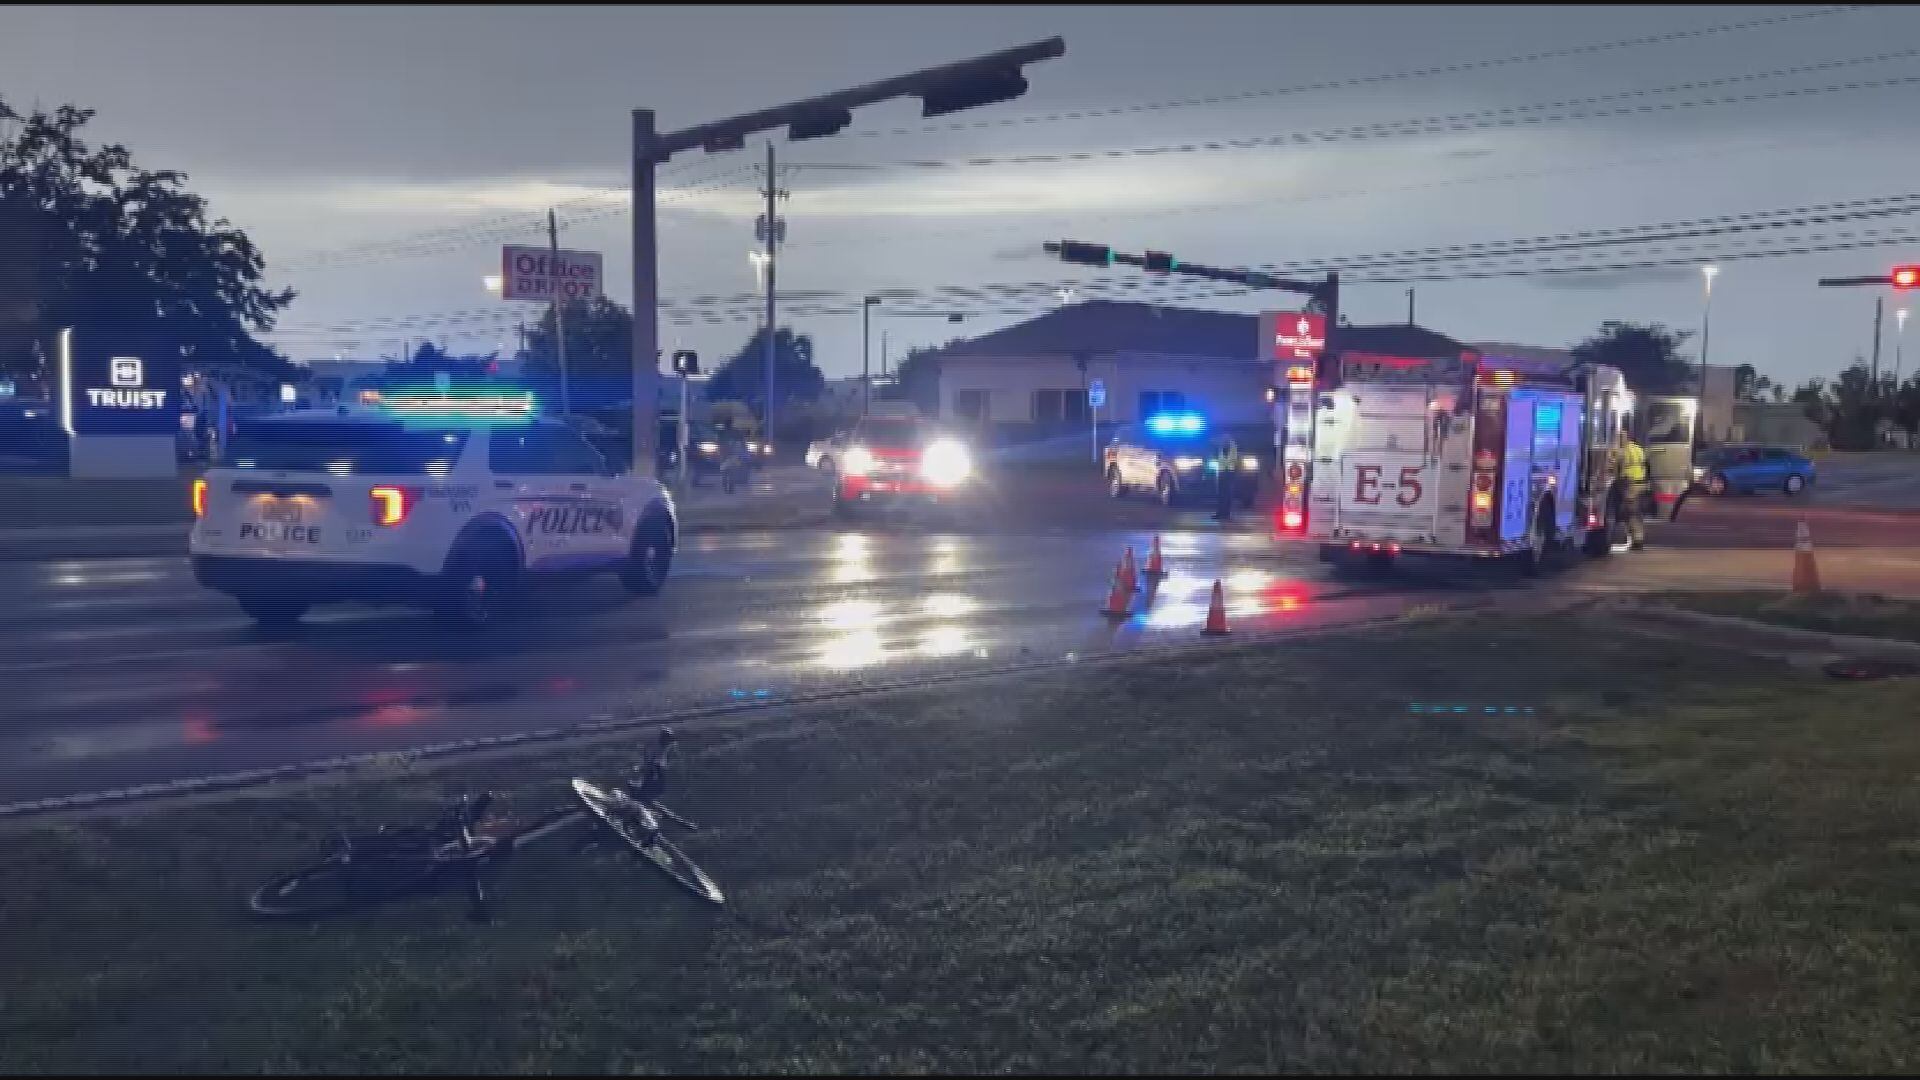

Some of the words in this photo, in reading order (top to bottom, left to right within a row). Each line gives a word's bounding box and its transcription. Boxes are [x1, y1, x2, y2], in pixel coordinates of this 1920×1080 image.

[516, 253, 594, 279] Ofice
[86, 388, 167, 408] TRUIST
[1353, 464, 1425, 507] E-5
[240, 523, 320, 543] POLICE
[526, 506, 609, 535] POLICE
